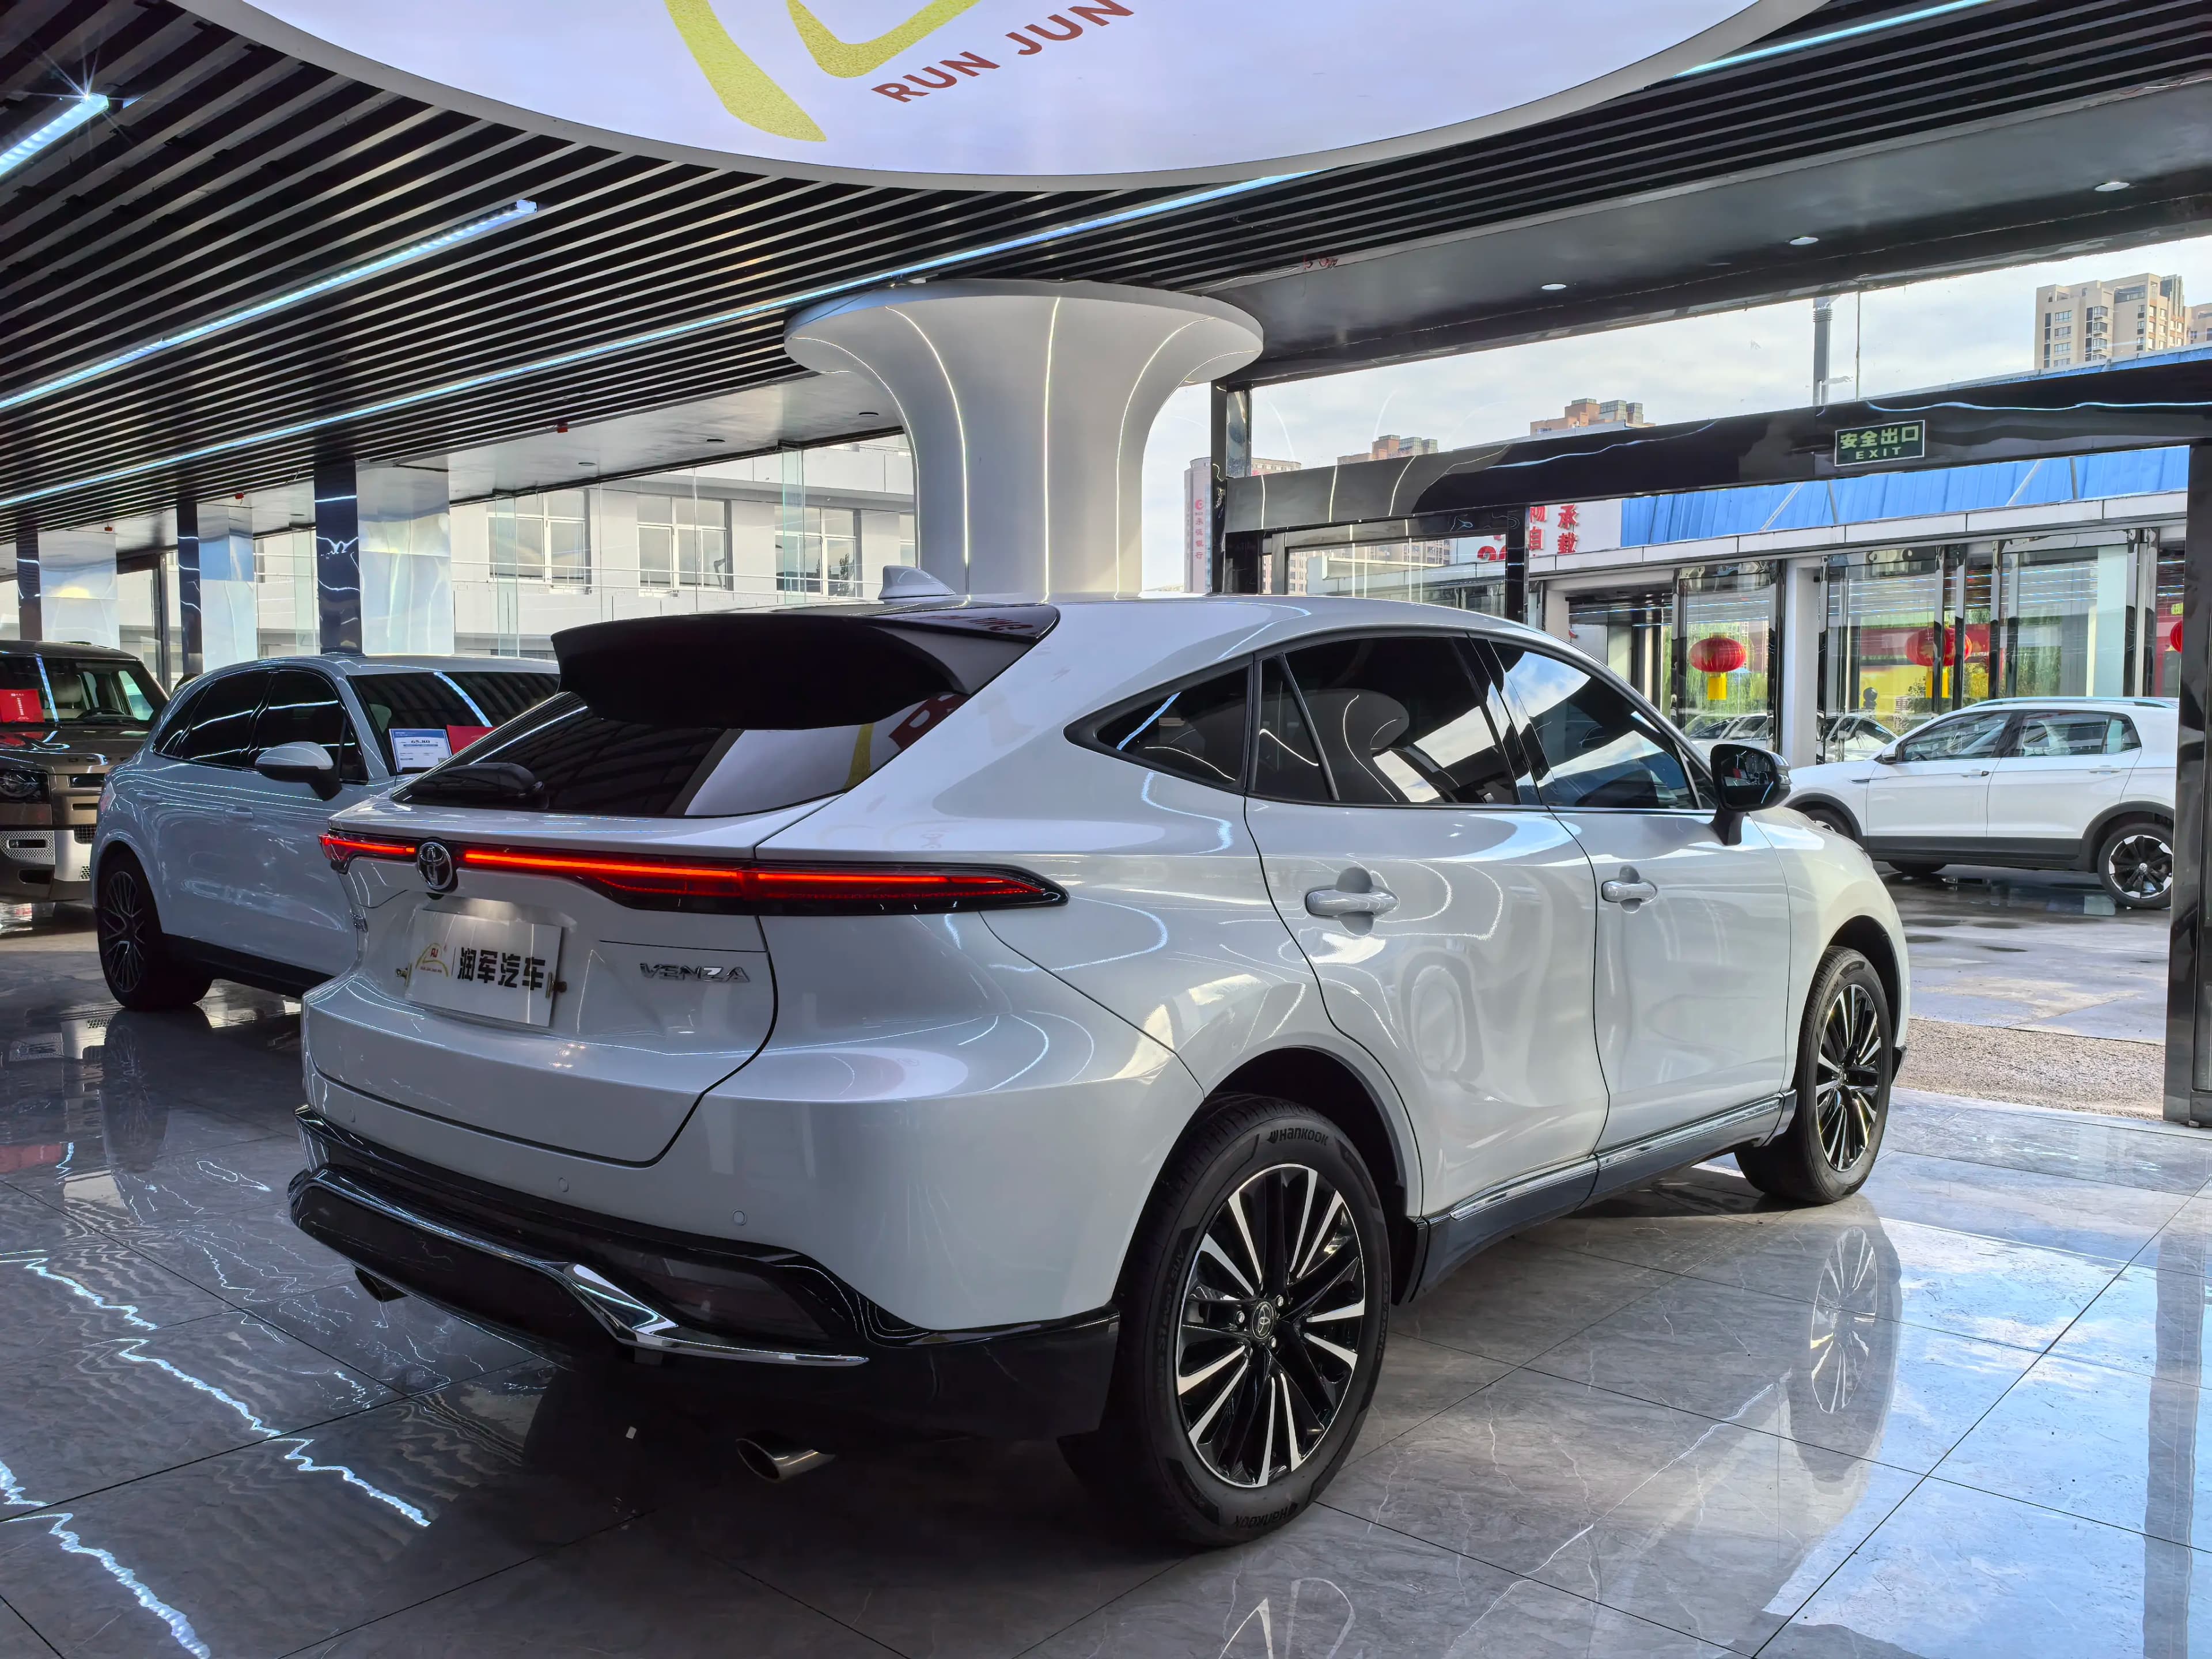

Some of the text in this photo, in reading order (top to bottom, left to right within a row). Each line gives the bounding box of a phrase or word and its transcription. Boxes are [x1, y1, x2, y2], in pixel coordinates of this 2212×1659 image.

[871, 0, 1135, 103] RUN JUN
[1840, 425, 1919, 449] 安全出口
[1855, 446, 1902, 460] EXIT
[457, 946, 546, 991] 润军汽车
[639, 963, 751, 983] VENZA
